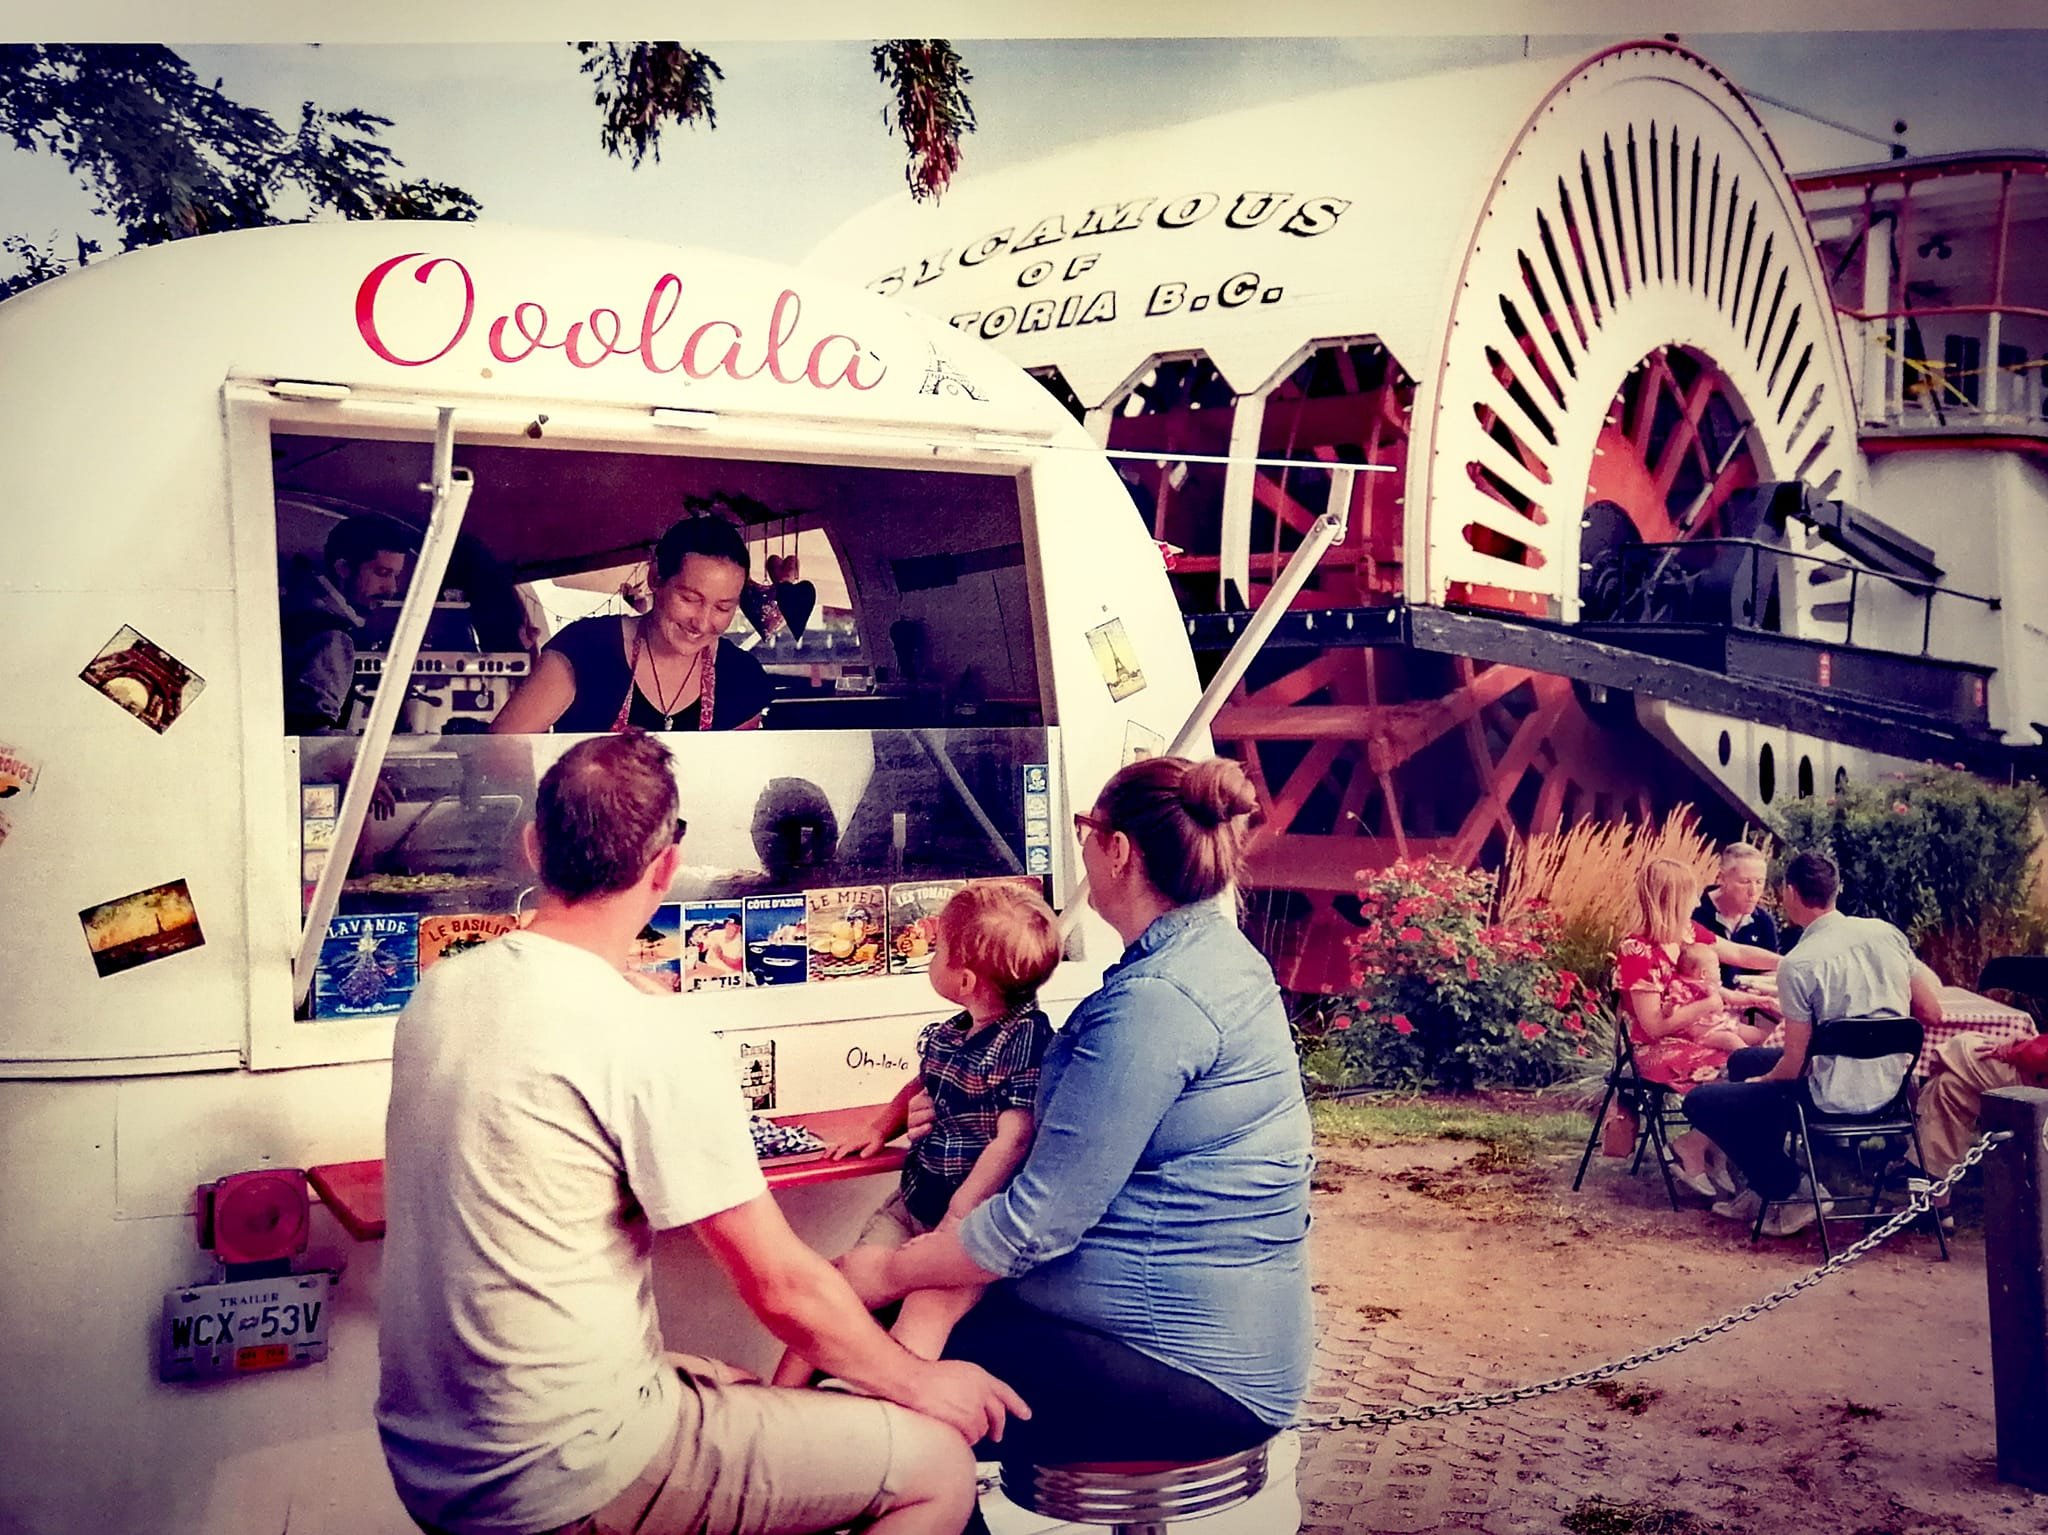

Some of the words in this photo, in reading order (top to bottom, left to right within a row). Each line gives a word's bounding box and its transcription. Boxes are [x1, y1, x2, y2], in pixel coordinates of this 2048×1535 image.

[1017, 253, 1102, 288] OF
[1145, 272, 1285, 317] B.C.
[355, 252, 887, 391] Ooolala
[747, 899, 771, 910] CÔTE
[772, 898, 804, 909] D'AZUR
[809, 895, 830, 912] LE
[838, 890, 878, 905] MIEL
[328, 918, 409, 938] LAVANDE
[428, 924, 448, 942] LE
[693, 975, 741, 989] PTIS
[219, 1292, 280, 1308] TRAILER
